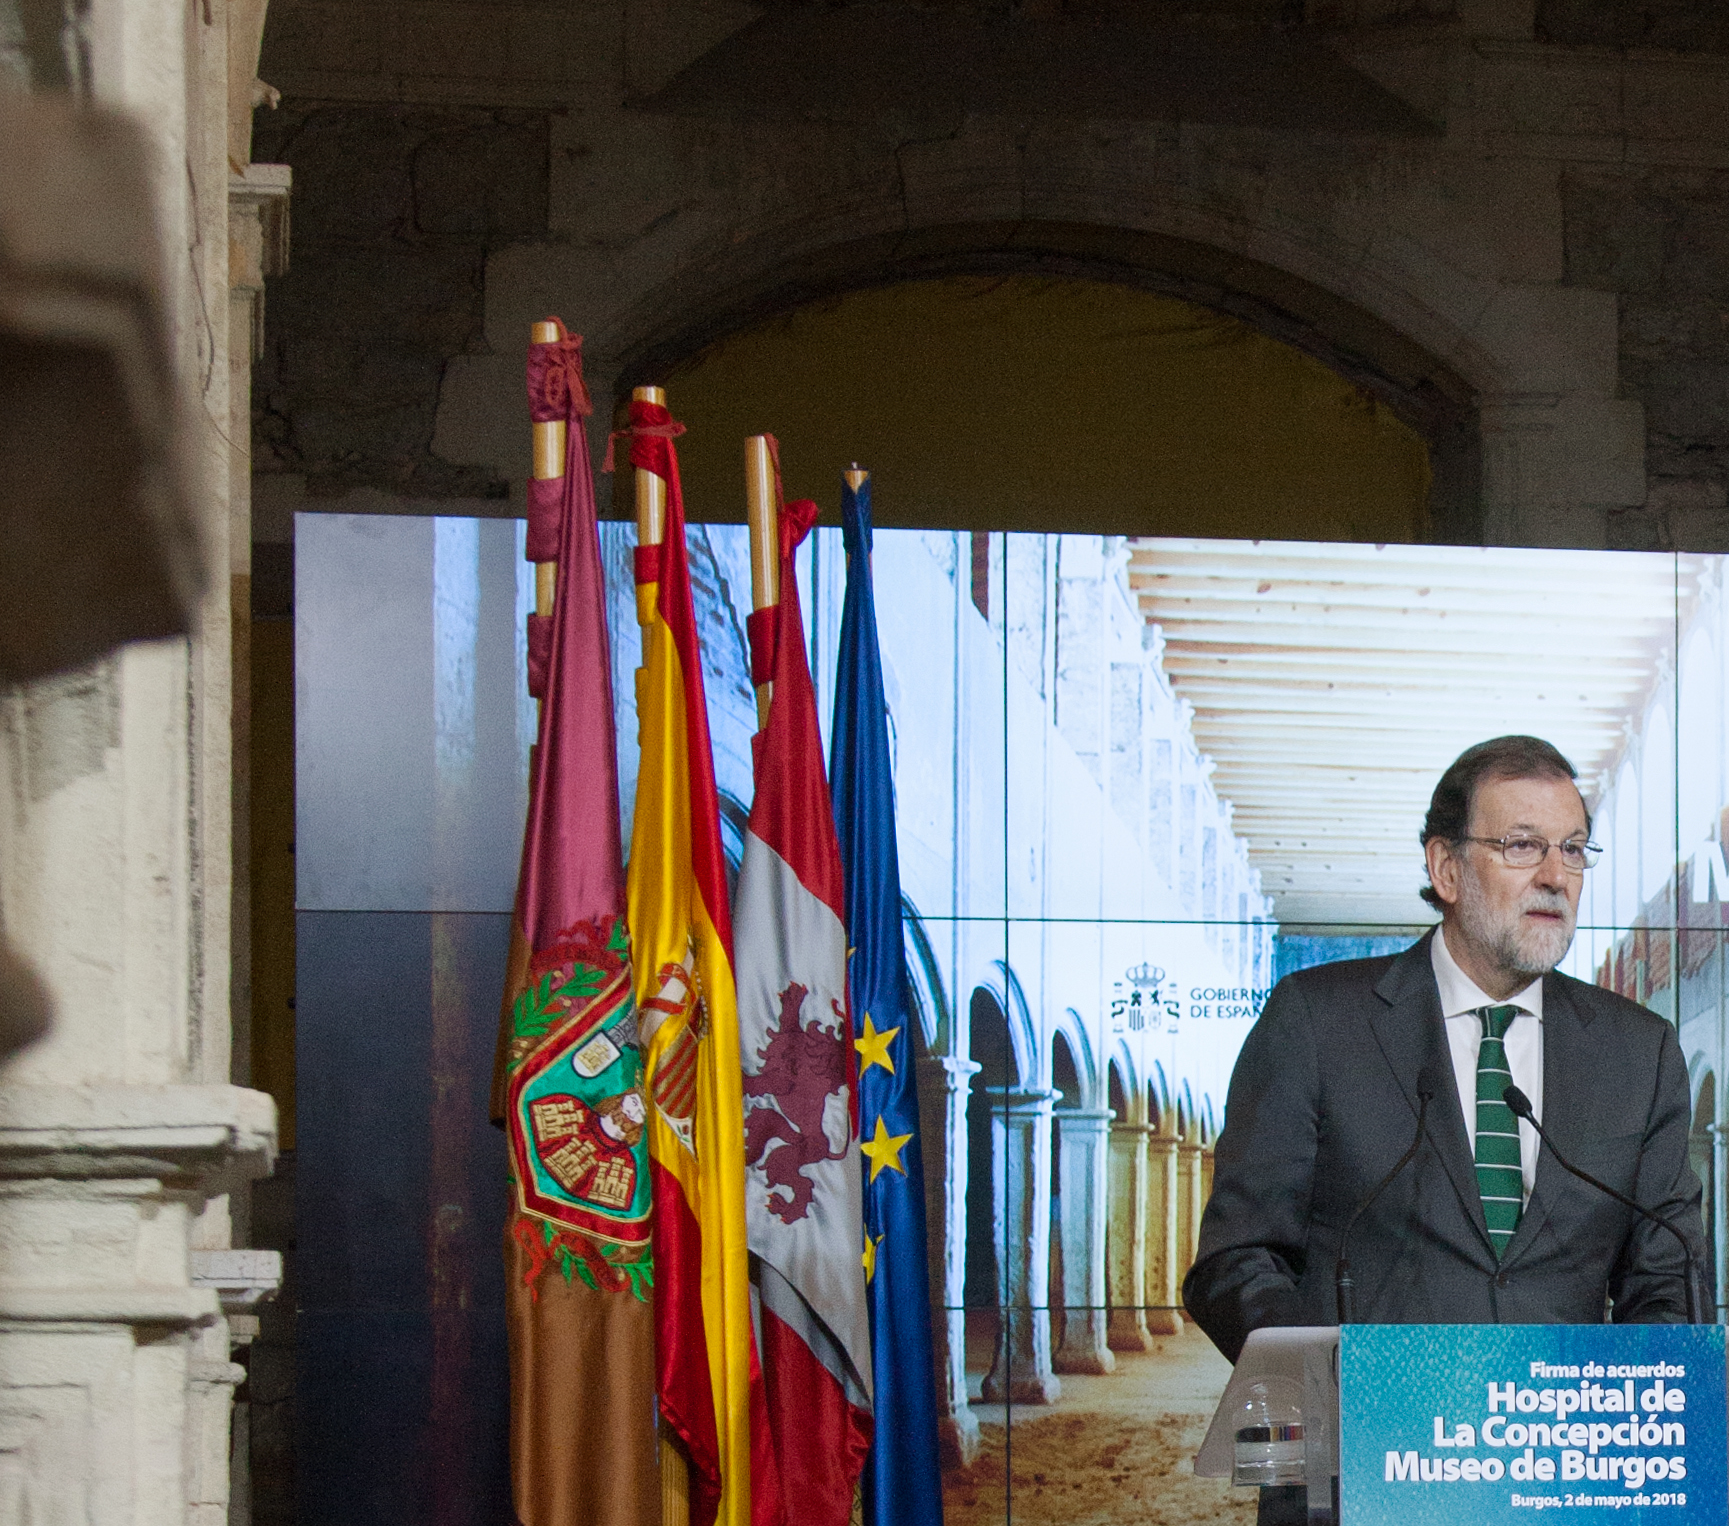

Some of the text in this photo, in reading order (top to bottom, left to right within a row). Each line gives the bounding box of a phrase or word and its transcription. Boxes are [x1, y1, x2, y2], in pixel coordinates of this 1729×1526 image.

[1190, 1006, 1211, 1018] DE
[1530, 1362, 1685, 1378] Firma de acuerdos
[1488, 1380, 1685, 1420] Hospital de
[1434, 1415, 1685, 1453] La Concepción
[1385, 1449, 1686, 1488] Museo de Burgos
[1511, 1493, 1686, 1509] Burgos, 2 de mayo de 2018
